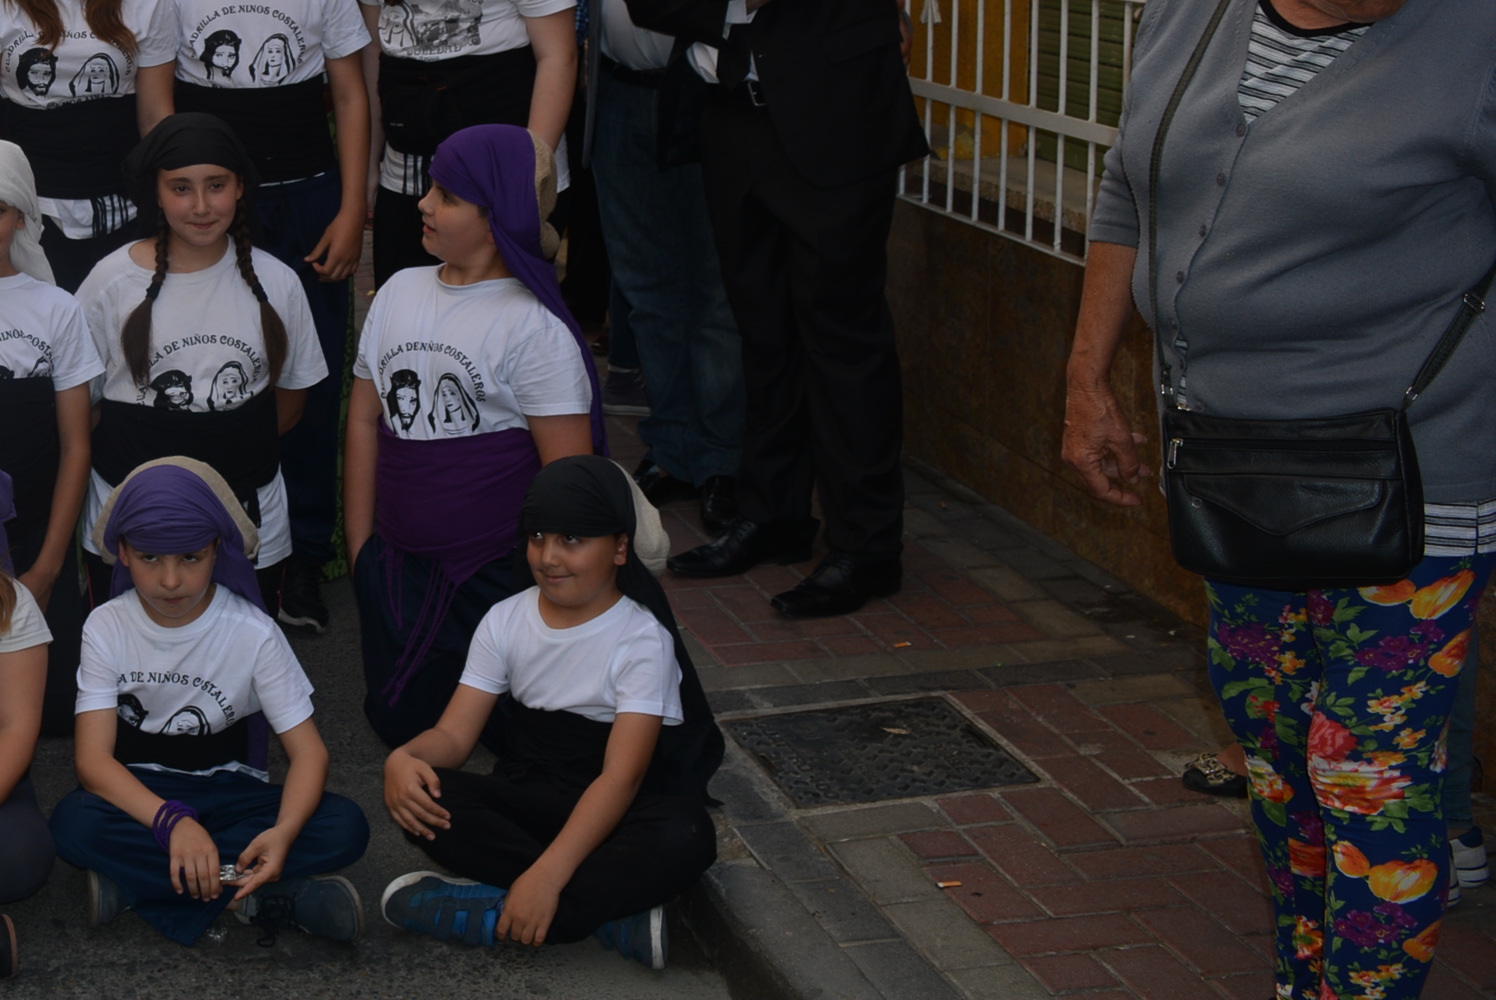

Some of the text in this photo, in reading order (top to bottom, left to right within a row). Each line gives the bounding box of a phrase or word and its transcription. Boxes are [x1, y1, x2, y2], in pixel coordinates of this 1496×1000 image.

[222, 5, 236, 15] DE
[164, 341, 181, 354] DE
[183, 333, 217, 348] NIÑOS
[406, 341, 421, 352] DE
[444, 345, 486, 402] COSTALEROS
[131, 670, 144, 683] DE
[147, 670, 189, 686] NIÑOS
